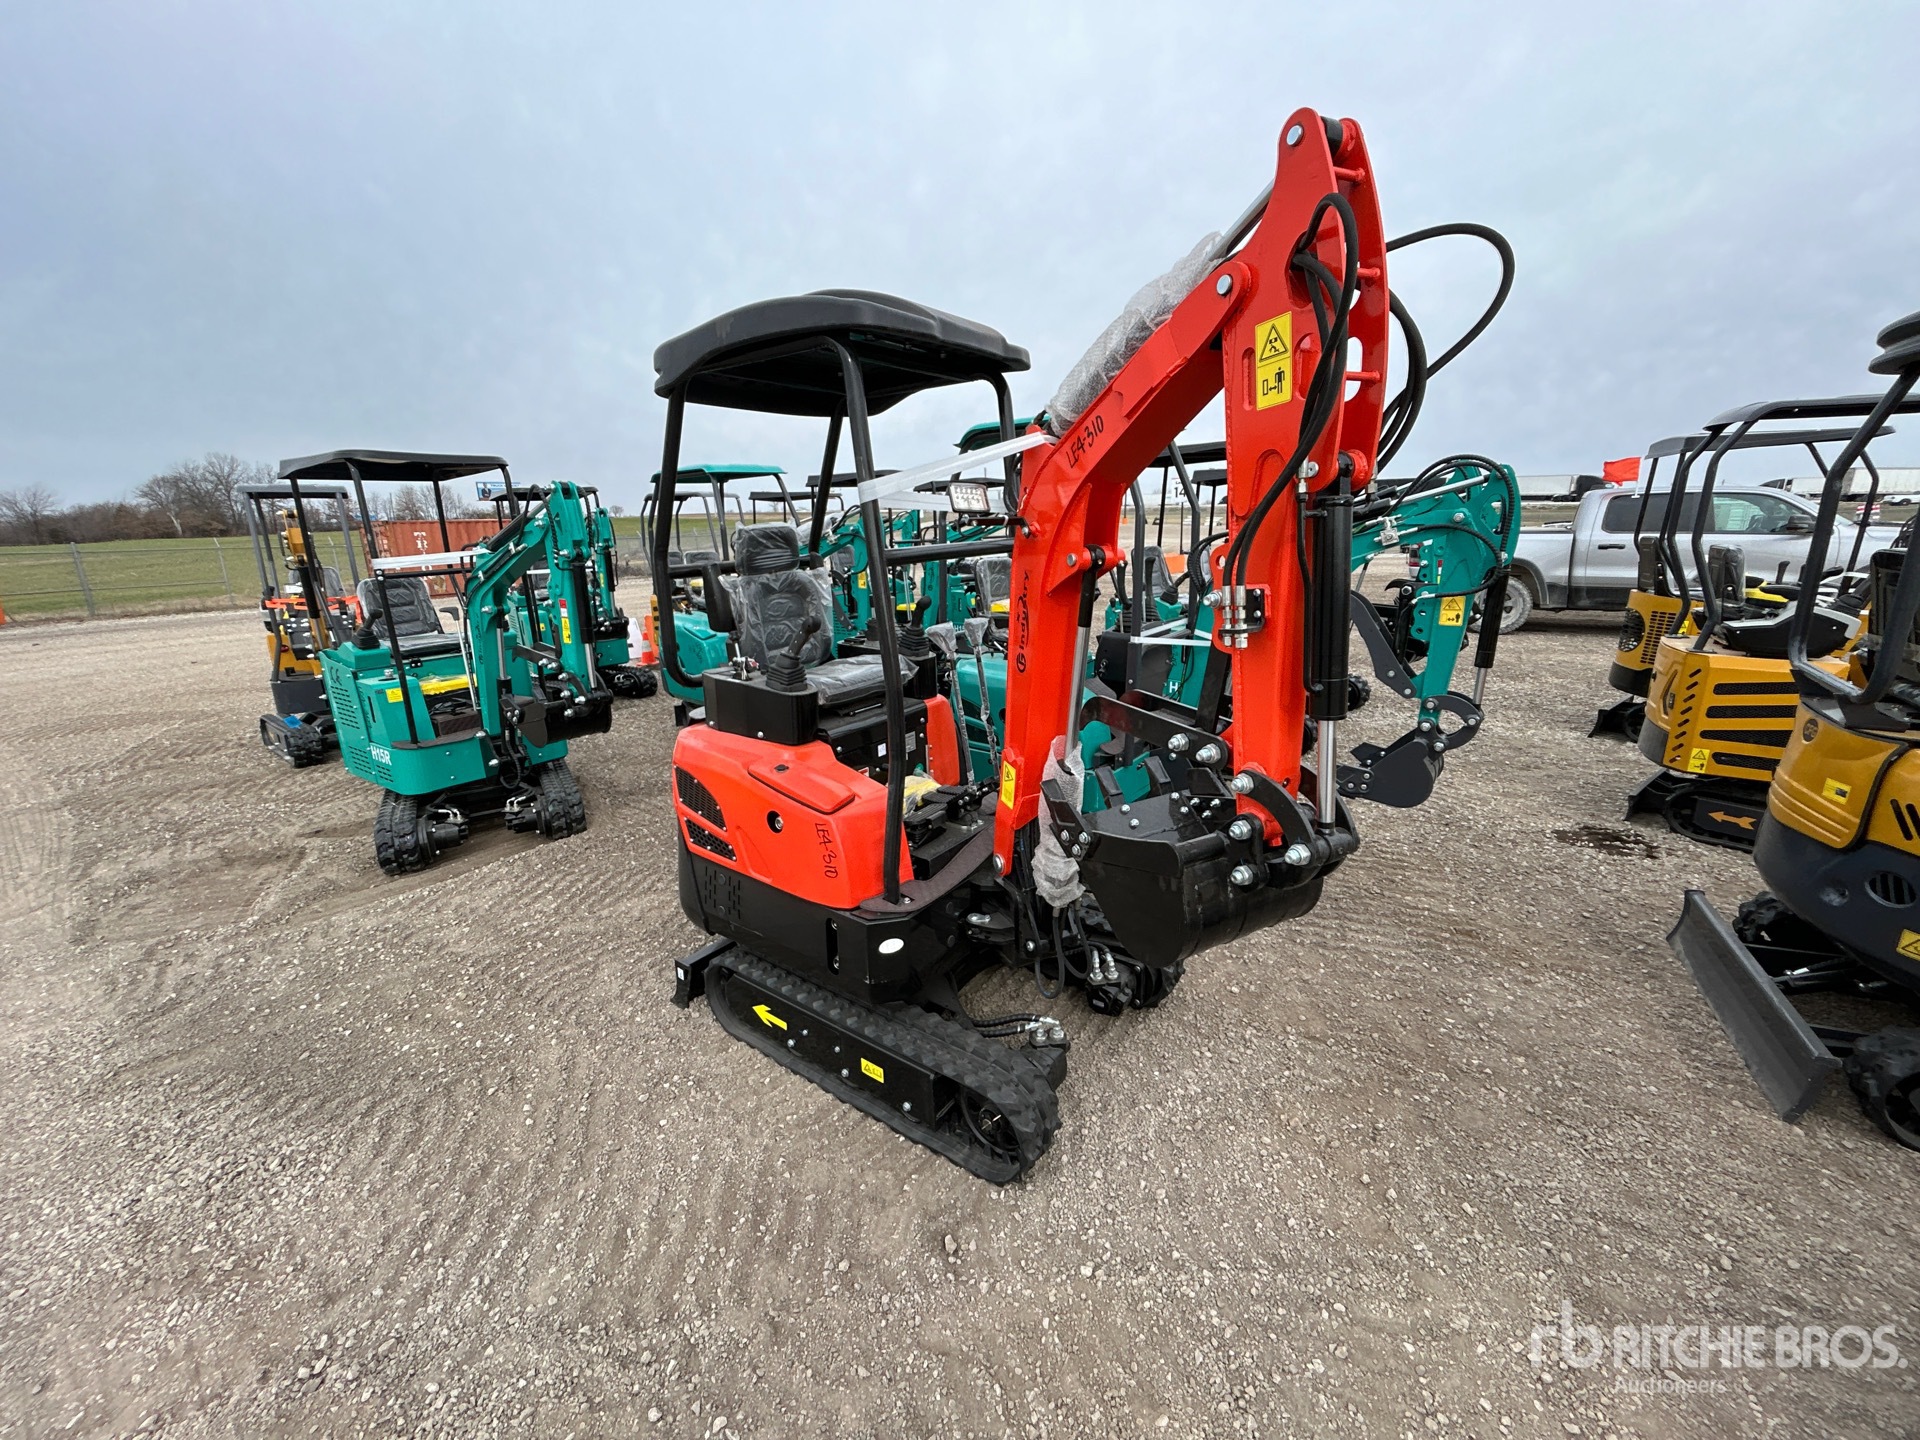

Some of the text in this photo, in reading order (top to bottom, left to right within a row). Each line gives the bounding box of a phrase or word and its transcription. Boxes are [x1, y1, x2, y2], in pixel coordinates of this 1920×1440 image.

[1065, 414, 1104, 469] LE4-310
[370, 744, 393, 766] H15R
[815, 822, 839, 879] LE4-310
